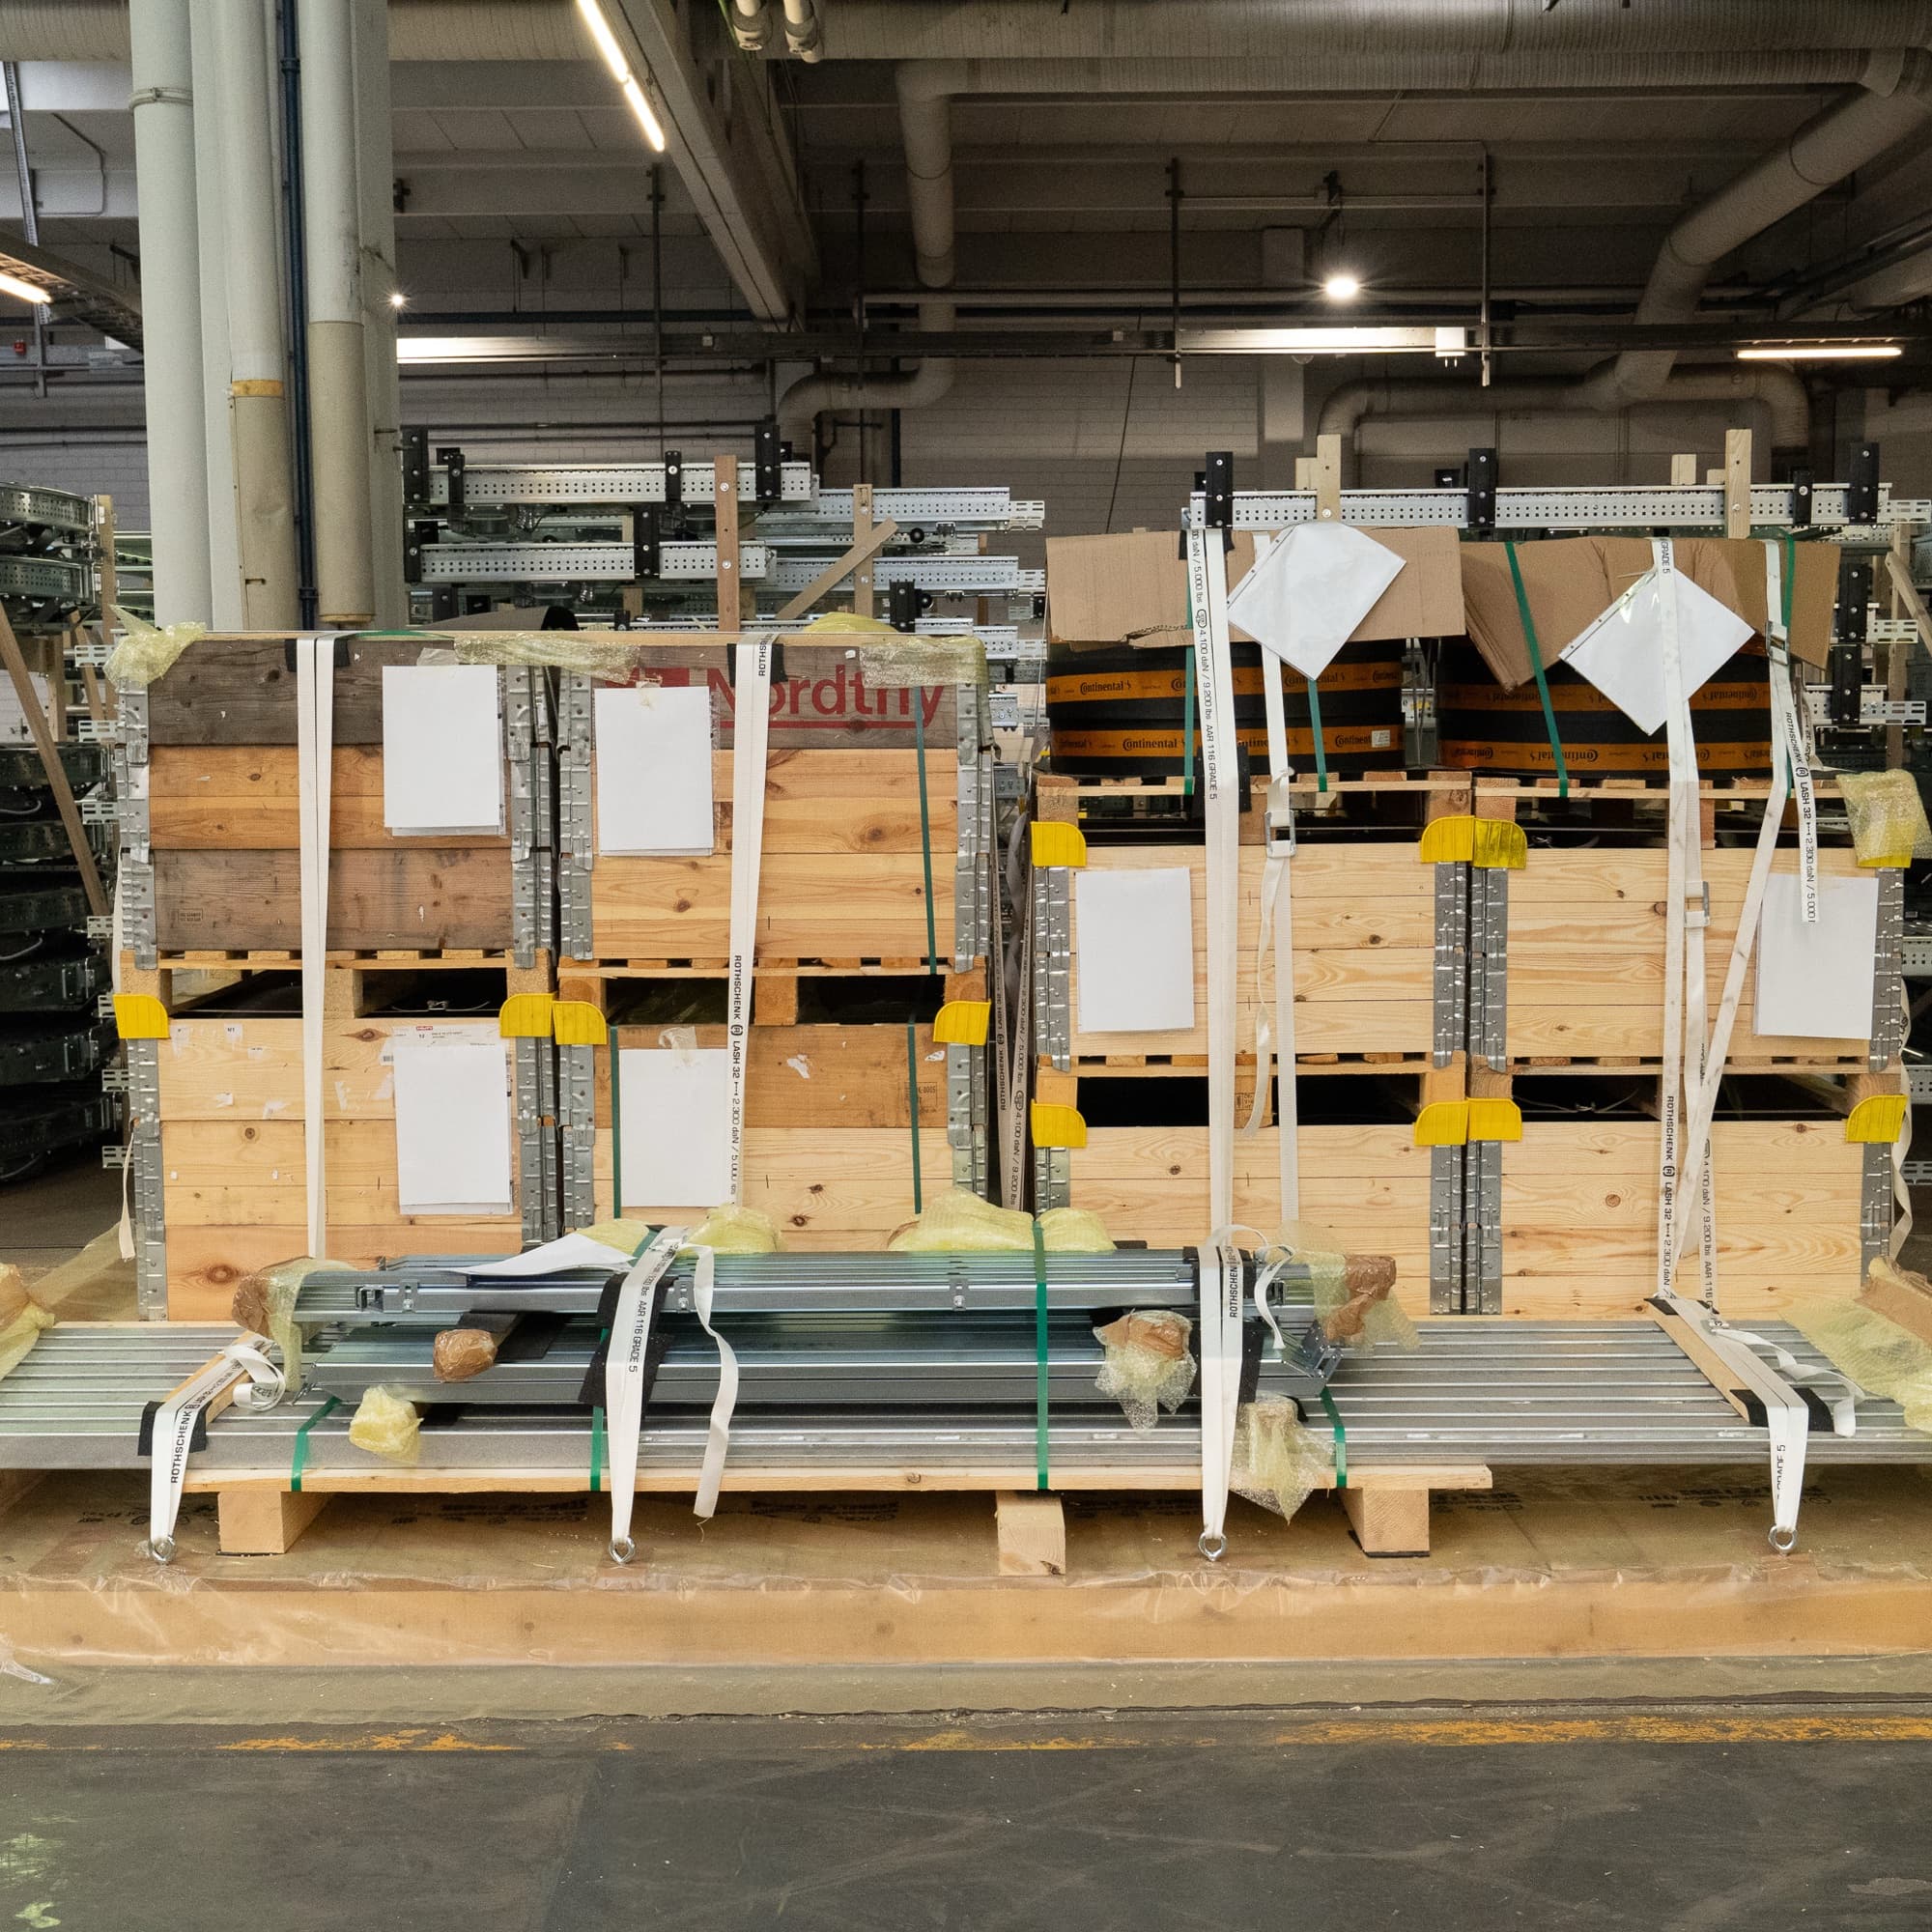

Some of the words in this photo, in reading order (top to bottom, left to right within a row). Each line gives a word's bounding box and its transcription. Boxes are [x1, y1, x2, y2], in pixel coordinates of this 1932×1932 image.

[1122, 738, 1178, 752] Continental
[1786, 712, 1804, 764] ROTHSCHENK
[1208, 745, 1216, 761] 116
[1208, 763, 1217, 791] GRADE
[1800, 782, 1809, 805] LASH
[1803, 807, 1812, 819] 32
[733, 954, 742, 1020] ROTHSCHENK
[732, 1040, 741, 1065] LASH
[732, 1066, 741, 1079] 32
[1665, 1095, 1675, 1161] ROTHSCHENK
[1664, 1181, 1673, 1206] LASH
[1663, 1208, 1672, 1221] 32
[1704, 1261, 1713, 1278] AAR
[638, 1300, 647, 1317] AAR
[634, 1319, 644, 1334] 116
[630, 1336, 642, 1363] GRADE
[170, 1410, 192, 1484] ROTHSCHENK
